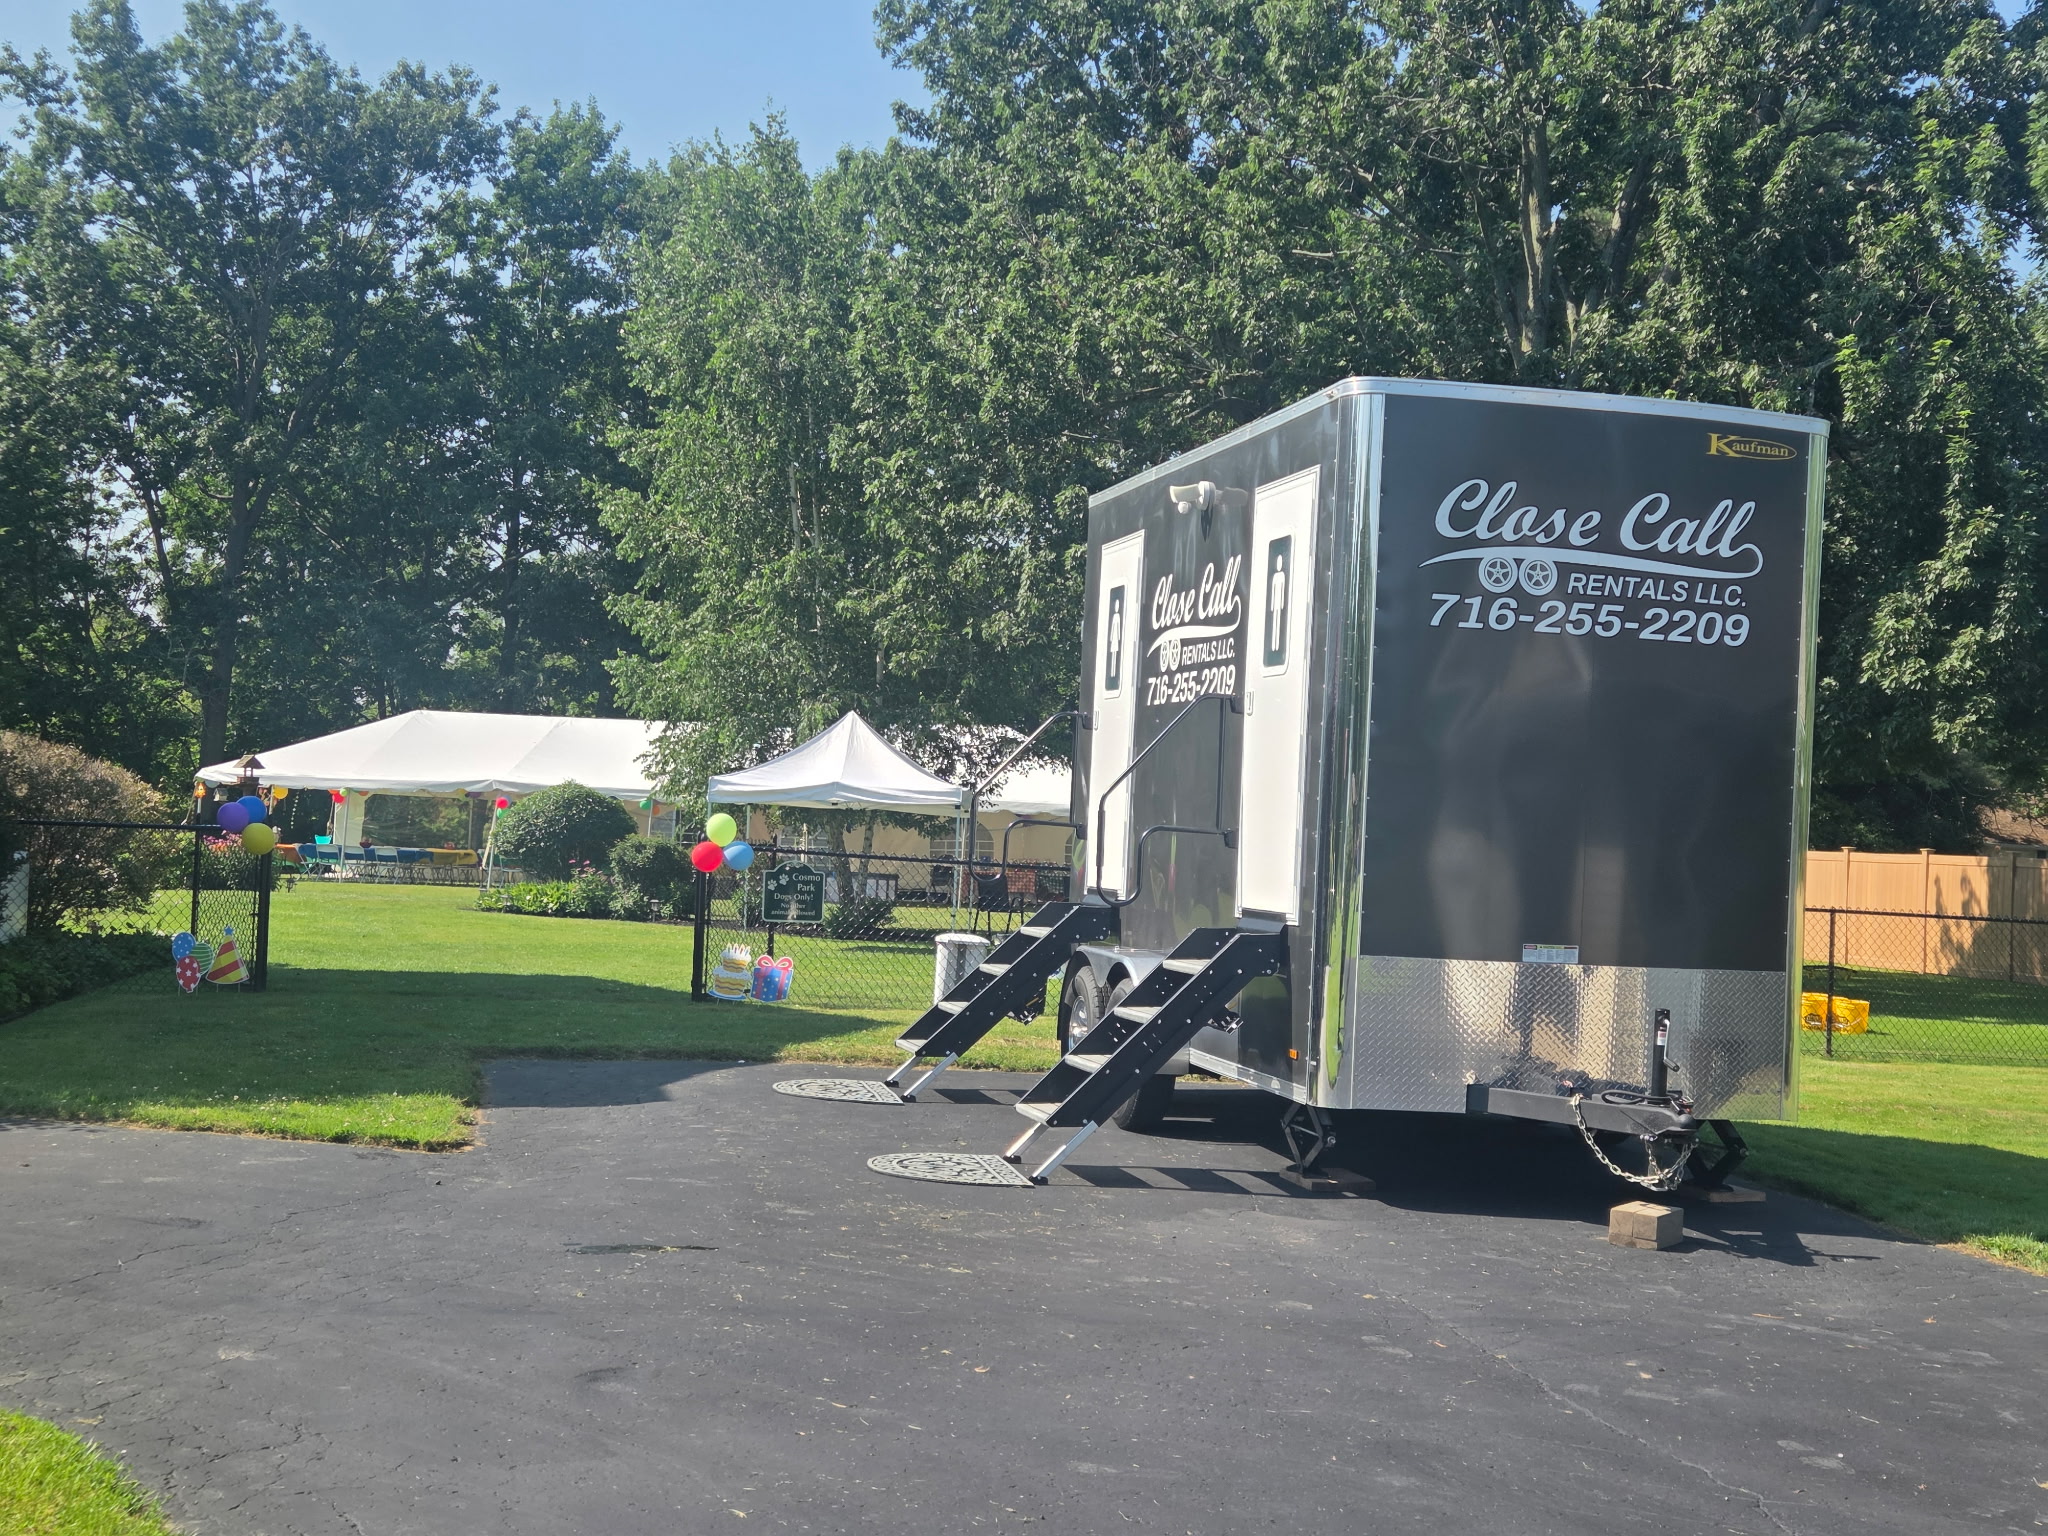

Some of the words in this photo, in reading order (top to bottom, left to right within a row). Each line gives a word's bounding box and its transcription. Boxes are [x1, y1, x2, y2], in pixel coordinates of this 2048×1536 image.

[1706, 432, 1789, 457] Kaufman
[1434, 478, 1601, 546] Close
[1619, 492, 1757, 558] Call
[1152, 573, 1196, 630] Close
[1198, 554, 1242, 620] Call
[1567, 572, 1689, 602] RENTALS
[1694, 582, 1746, 607] LLC.
[1429, 592, 1751, 647] 716-255-2209
[1181, 641, 1217, 667] RENTALS
[1217, 637, 1236, 660] LLC.
[1146, 664, 1236, 706] 716-255-2209
[792, 873, 821, 882] Cosmo
[797, 883, 816, 892] Park
[774, 892, 792, 902] Dogs
[793, 893, 814, 902] Only!
